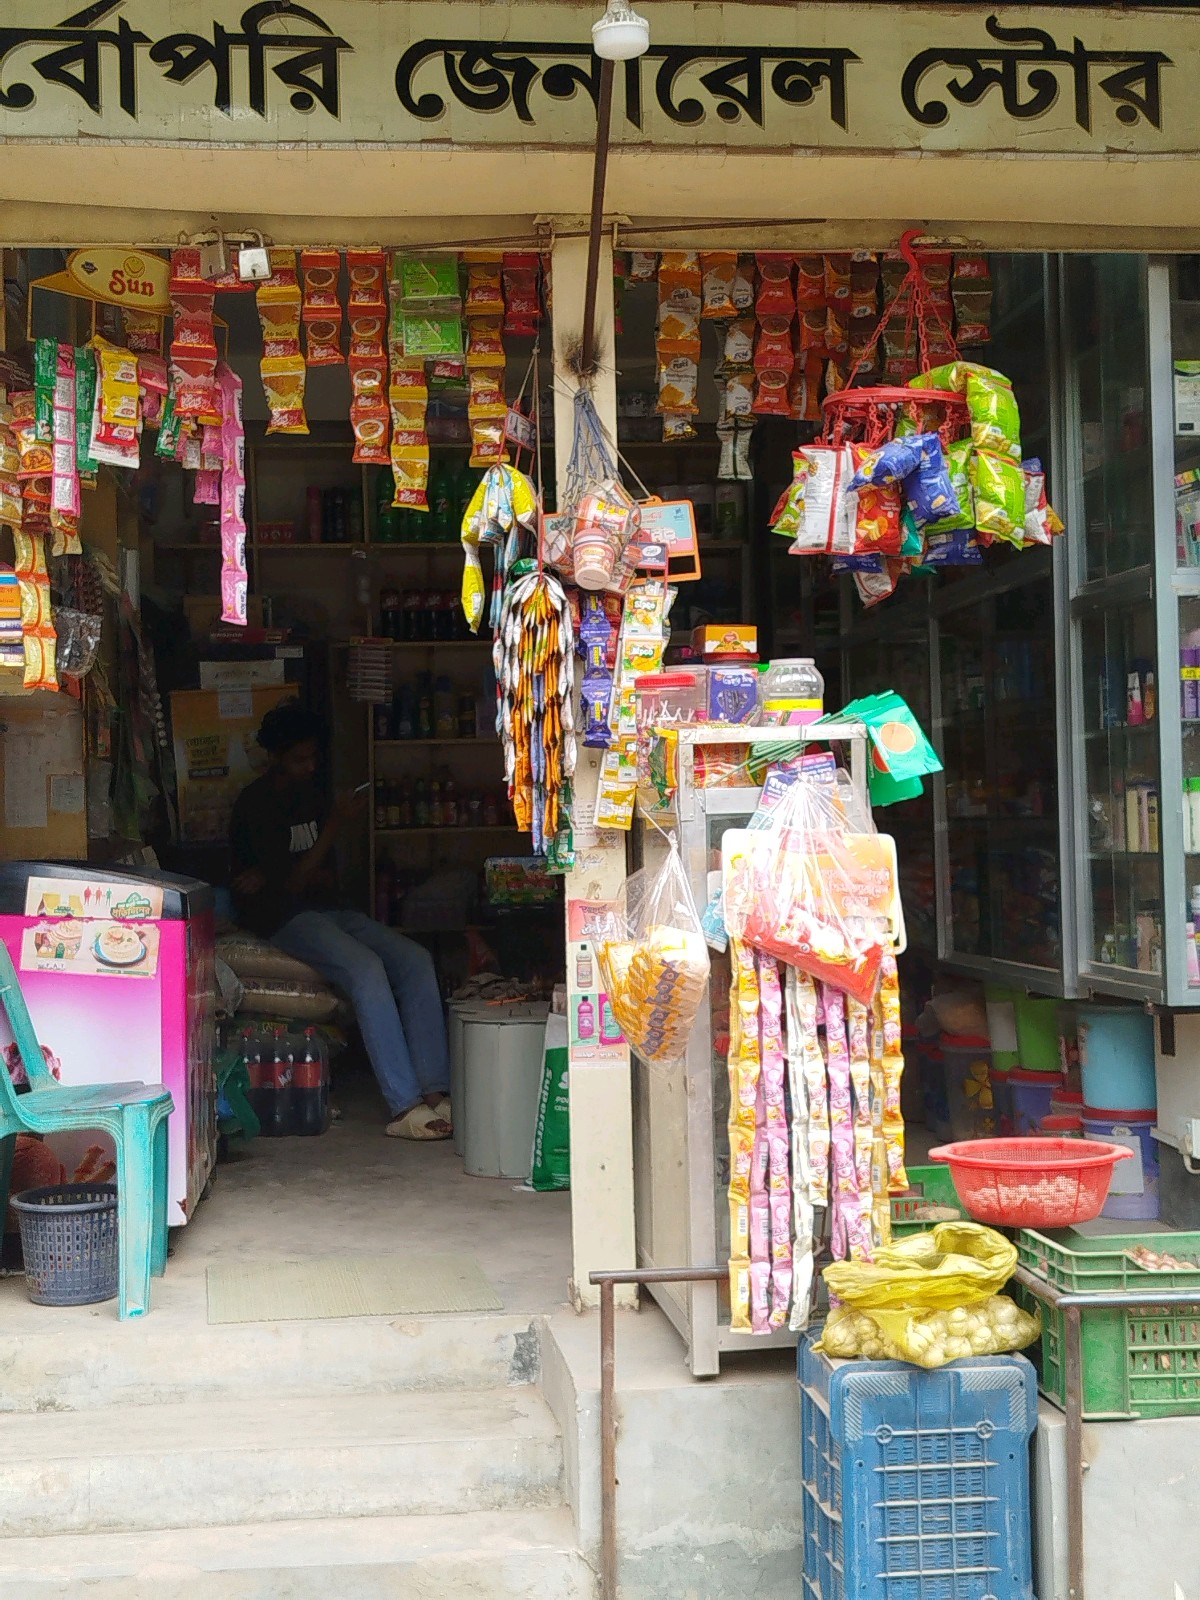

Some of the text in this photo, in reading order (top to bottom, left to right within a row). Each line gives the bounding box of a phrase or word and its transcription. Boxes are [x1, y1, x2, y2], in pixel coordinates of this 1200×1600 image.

[394, 38, 863, 132] জেনারেল
[900, 14, 1174, 136] স্টোর
[108, 269, 155, 297] Sun
